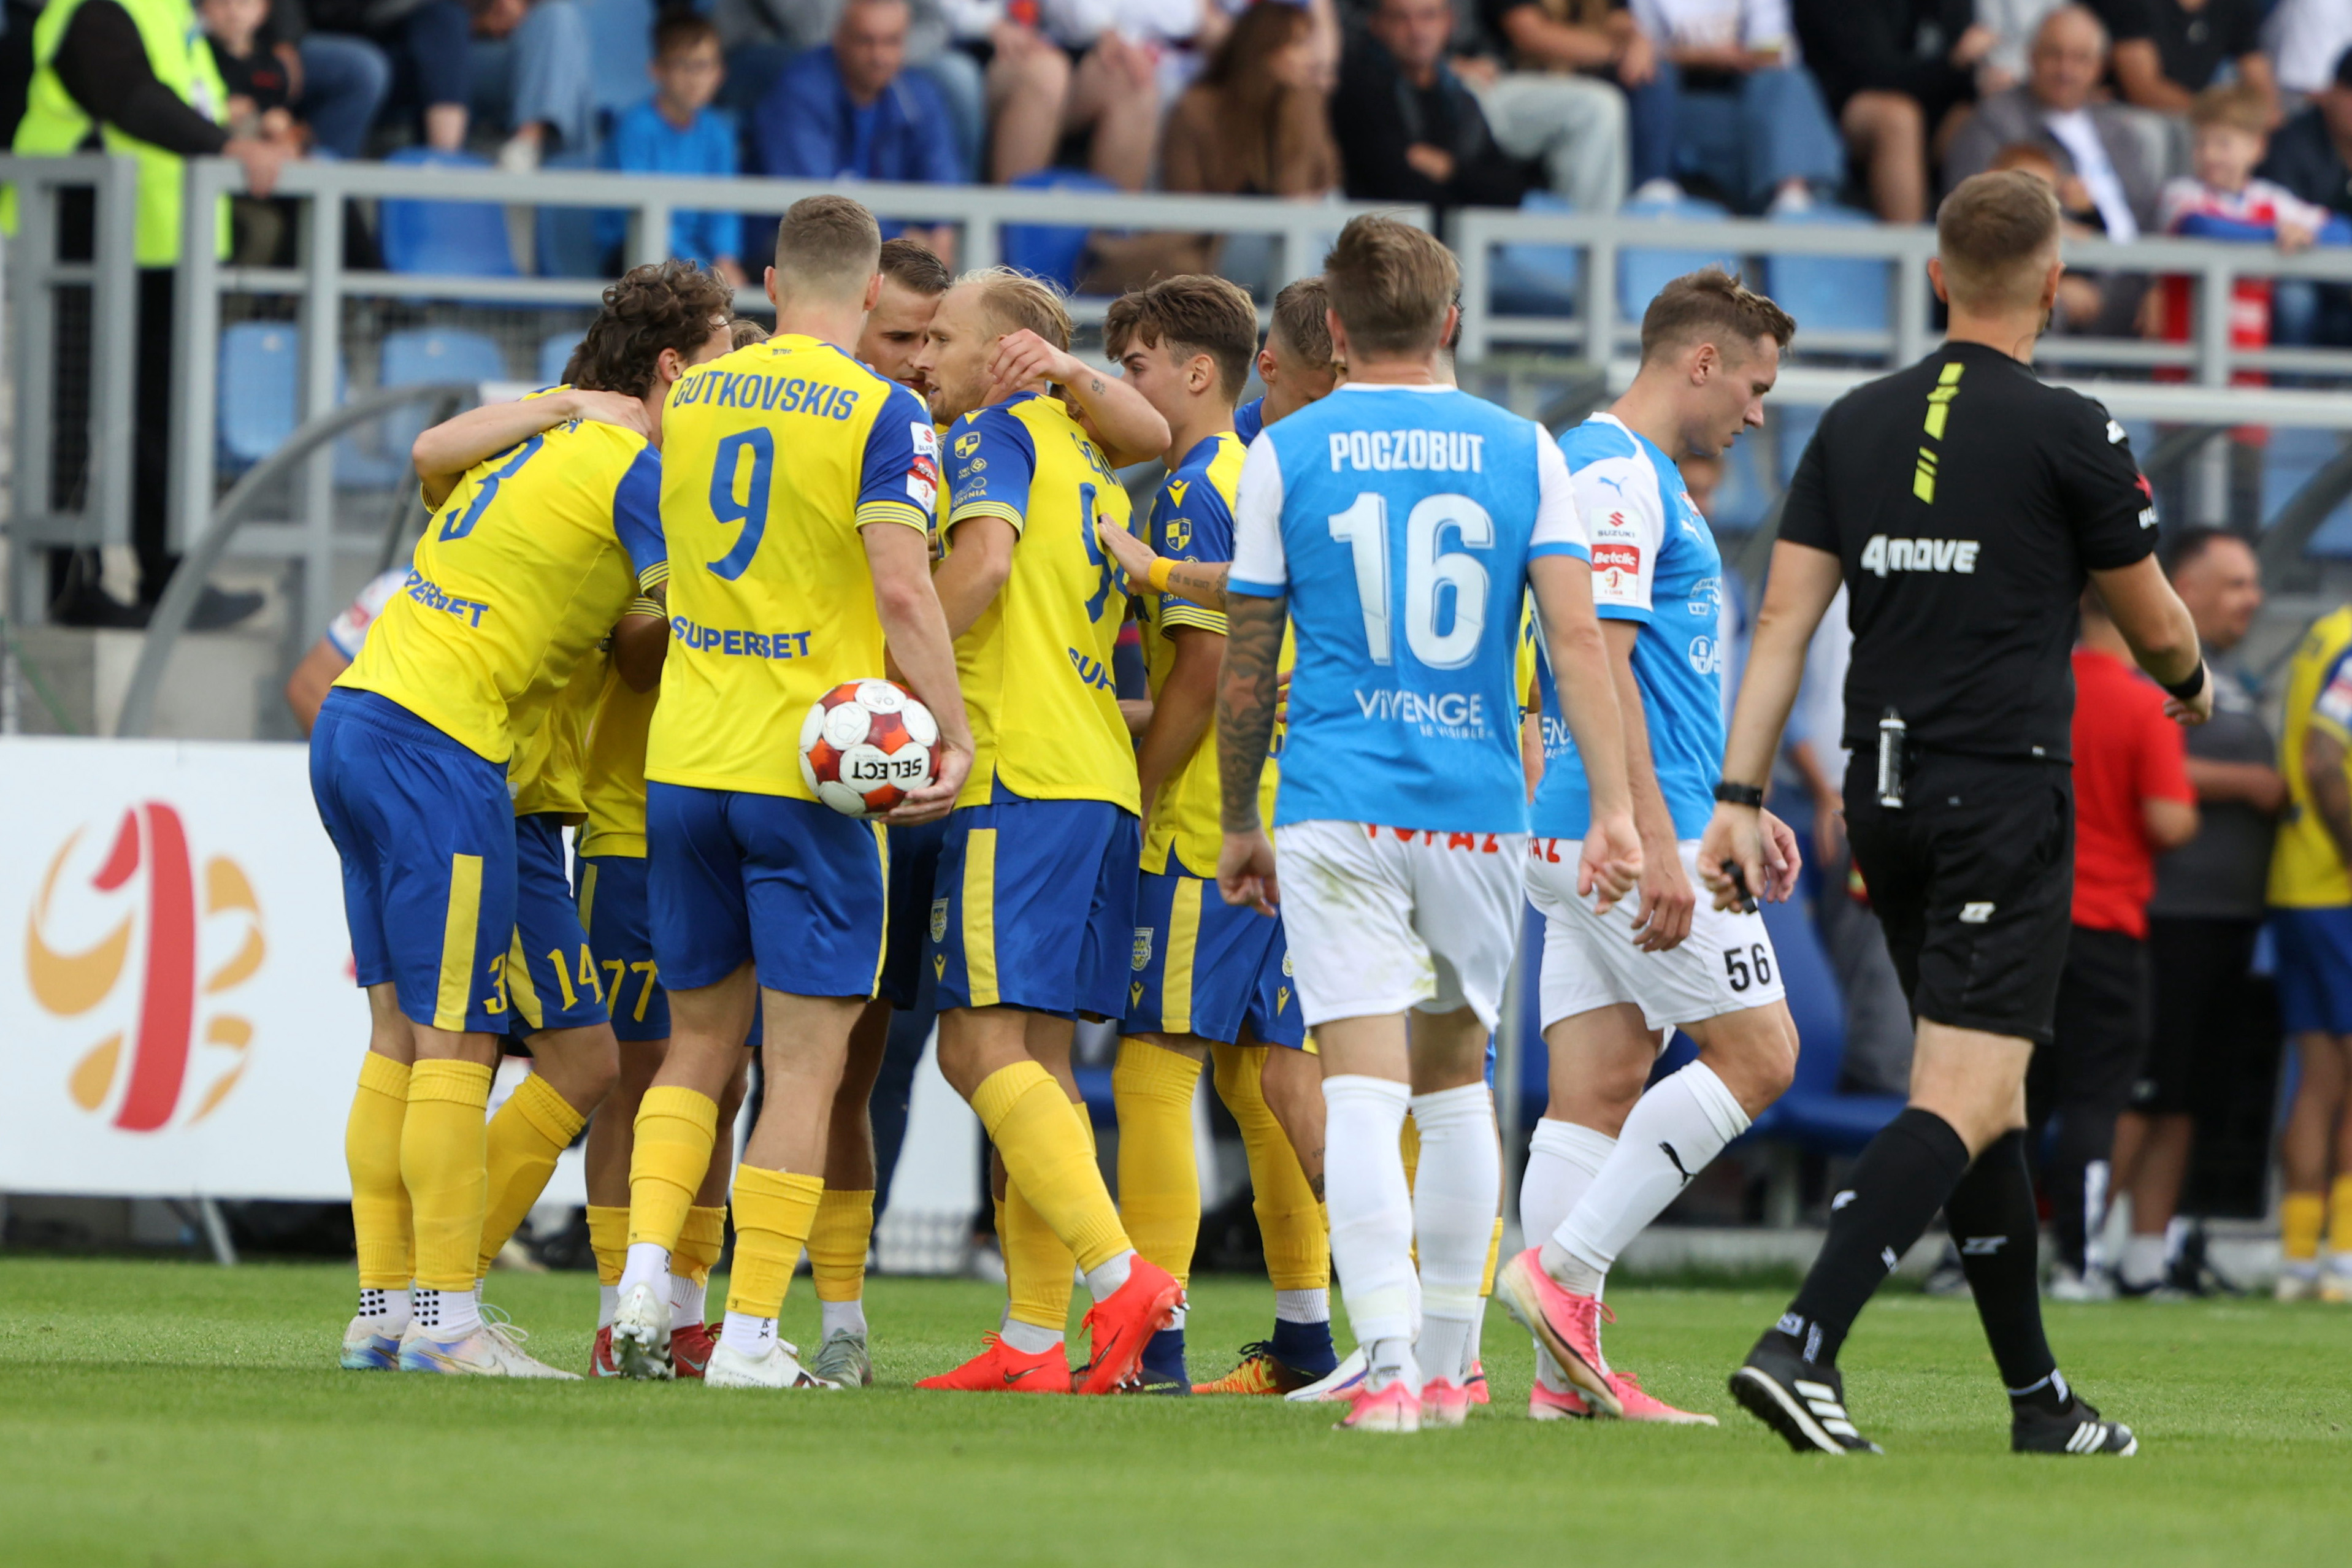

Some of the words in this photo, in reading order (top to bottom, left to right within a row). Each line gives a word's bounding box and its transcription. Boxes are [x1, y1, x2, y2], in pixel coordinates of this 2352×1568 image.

[673, 370, 859, 421] GUTKOVSKIS
[1329, 429, 1484, 473] POCZOBUT
[707, 426, 774, 581] 9
[1328, 492, 1495, 670] 16
[1594, 551, 1637, 566] Betclic
[670, 615, 811, 659] SUPERBET
[852, 757, 922, 780] SELECT
[483, 952, 508, 1014] 3
[546, 943, 603, 1012] 14
[601, 958, 658, 1022] 77
[1723, 943, 1771, 992] 56
